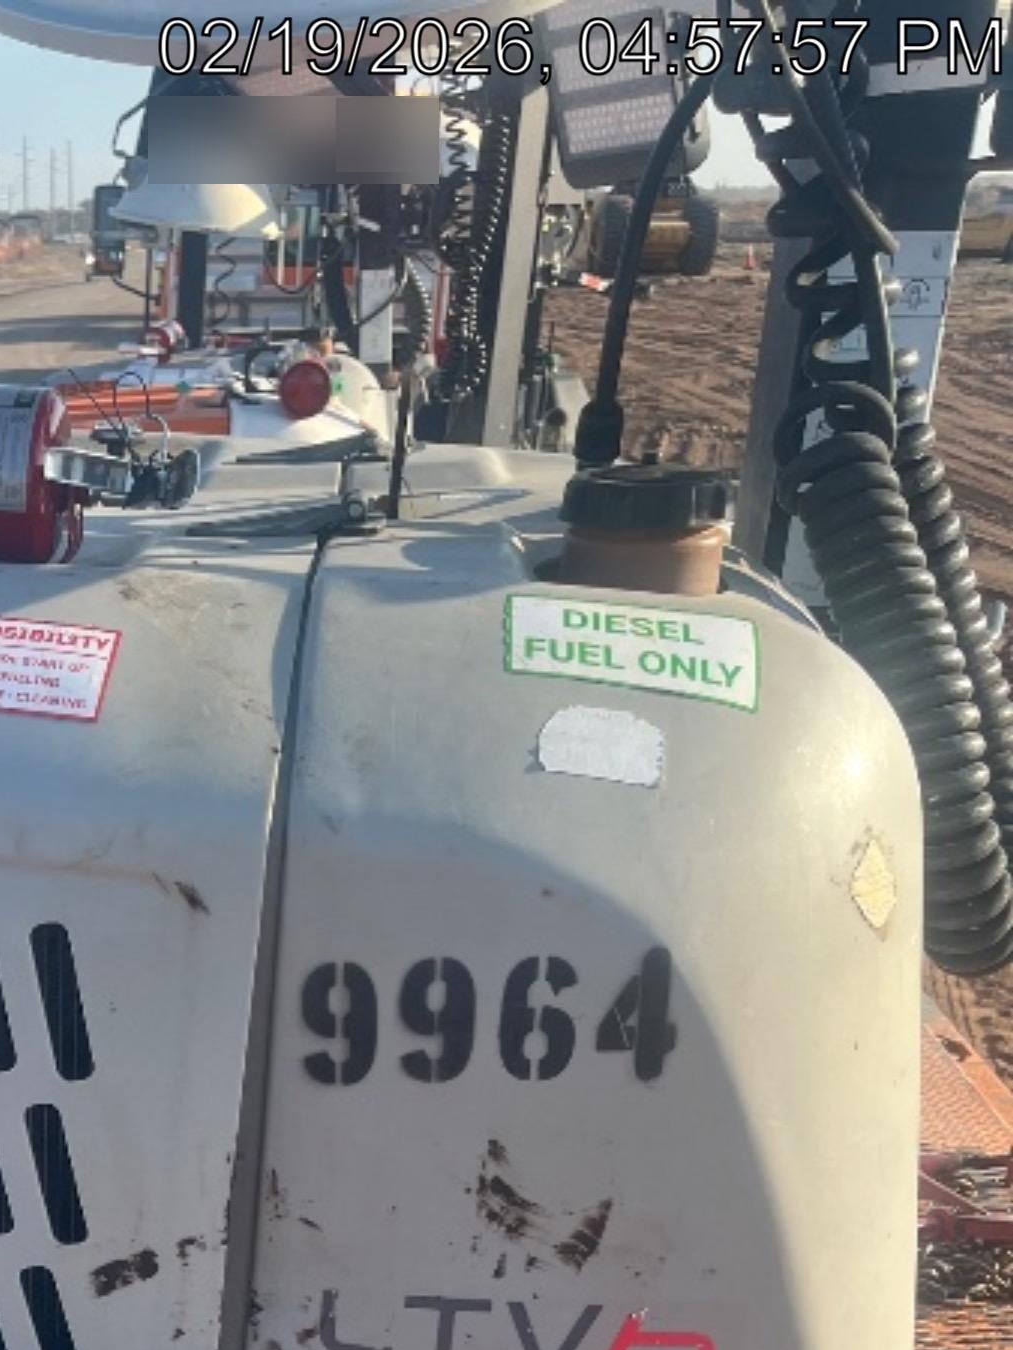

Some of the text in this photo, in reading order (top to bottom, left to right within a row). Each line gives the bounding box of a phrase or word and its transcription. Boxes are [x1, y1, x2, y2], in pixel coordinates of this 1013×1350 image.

[563, 609, 705, 645] DIESEL
[524, 636, 742, 688] FUEL ONLY
[301, 945, 677, 1087] 9964
